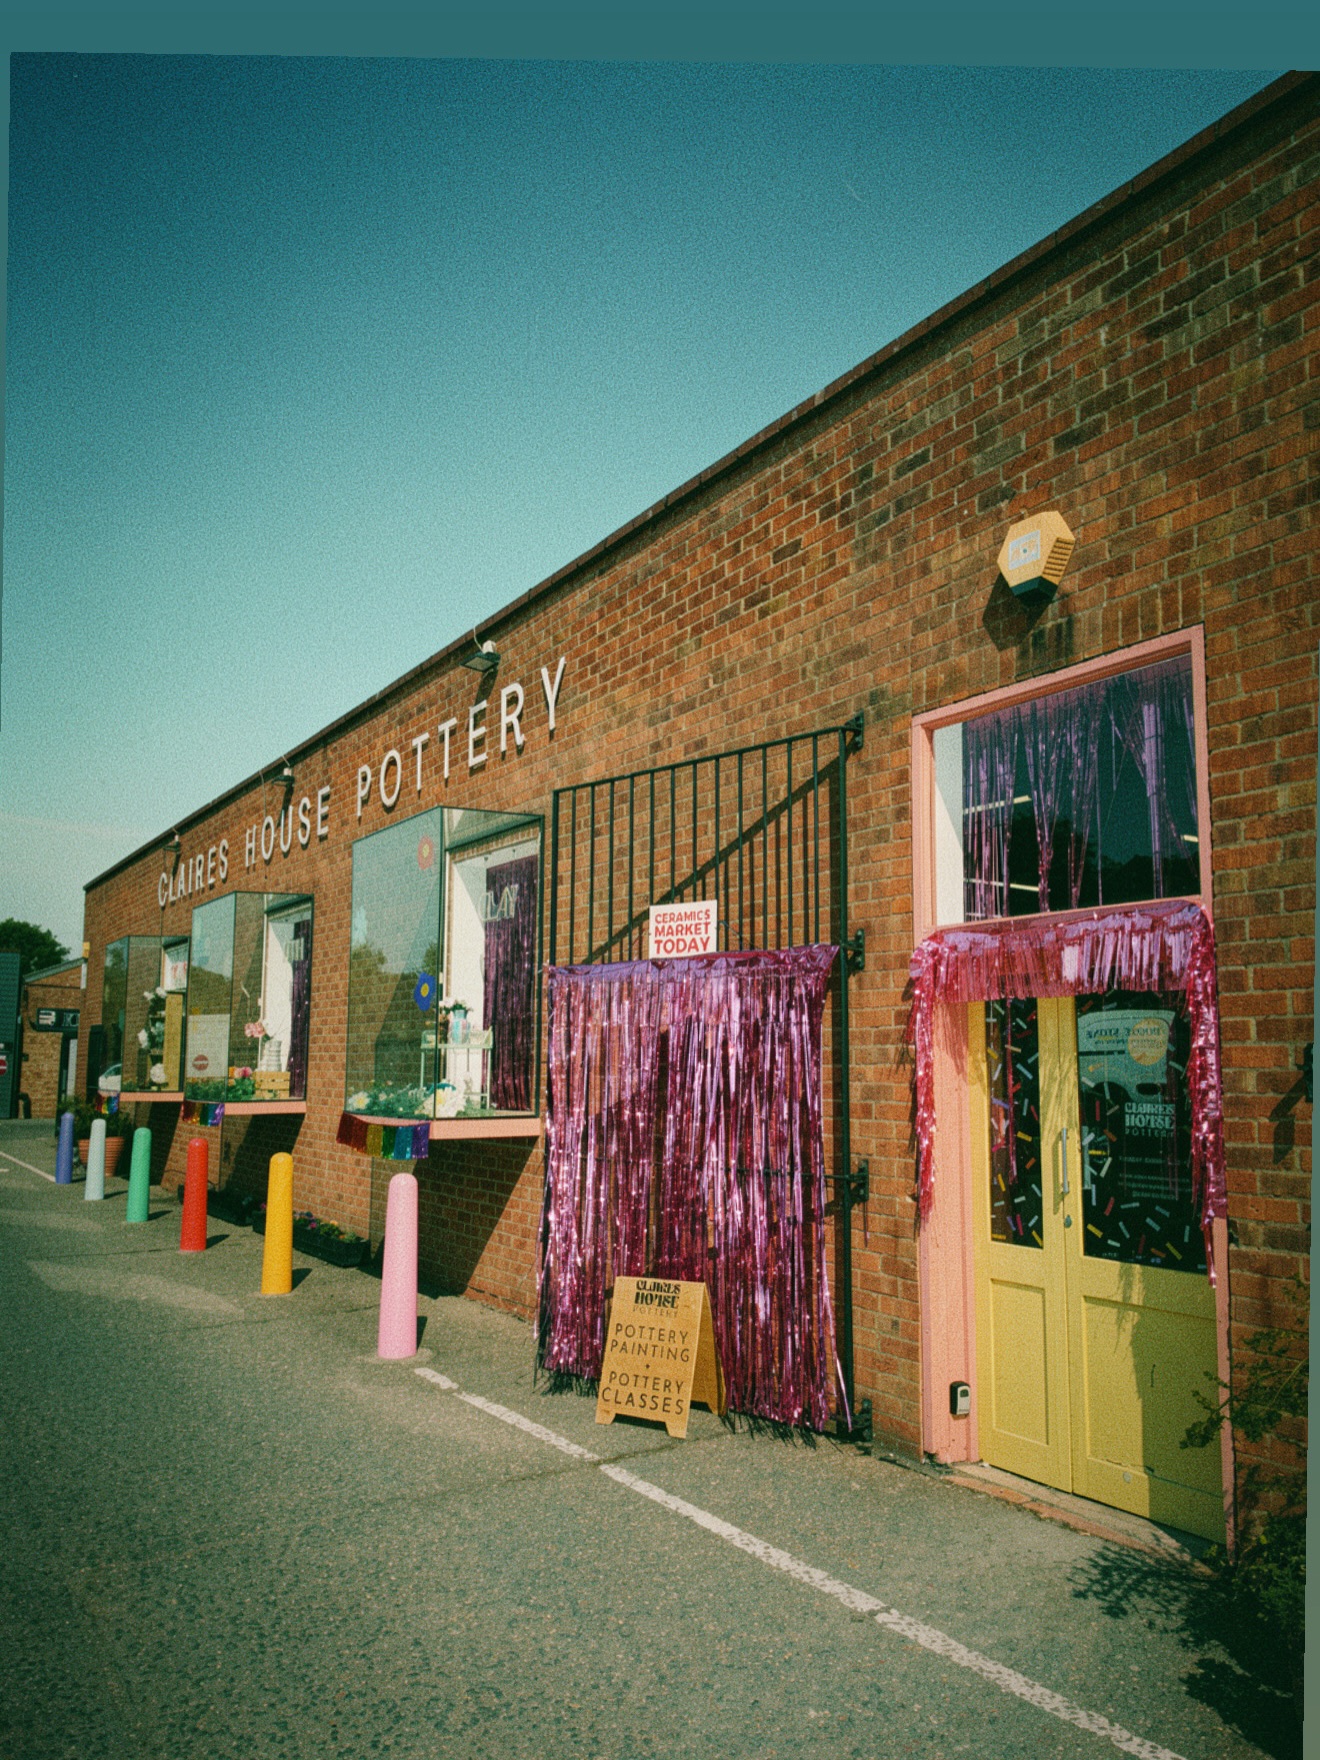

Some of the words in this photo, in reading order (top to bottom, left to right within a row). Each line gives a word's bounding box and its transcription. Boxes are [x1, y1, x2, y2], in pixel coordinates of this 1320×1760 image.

[157, 838, 229, 908] CLAIRES
[245, 784, 331, 868] HOUSE
[356, 656, 567, 818] POTTERY
[478, 883, 519, 921] CLAY
[654, 909, 711, 924] CERAMICS
[654, 921, 711, 938] MARKET
[654, 936, 711, 955] TODAY
[1124, 1113, 1175, 1129] HOUSE
[635, 1280, 681, 1295] CLAIRES
[634, 1292, 680, 1308] HOUSE
[632, 1306, 679, 1318] POTTERY
[615, 1322, 689, 1345] POTTERY
[610, 1338, 690, 1363] PAINTING
[608, 1370, 685, 1394] POTTERY
[601, 1386, 685, 1415] CLASSES
